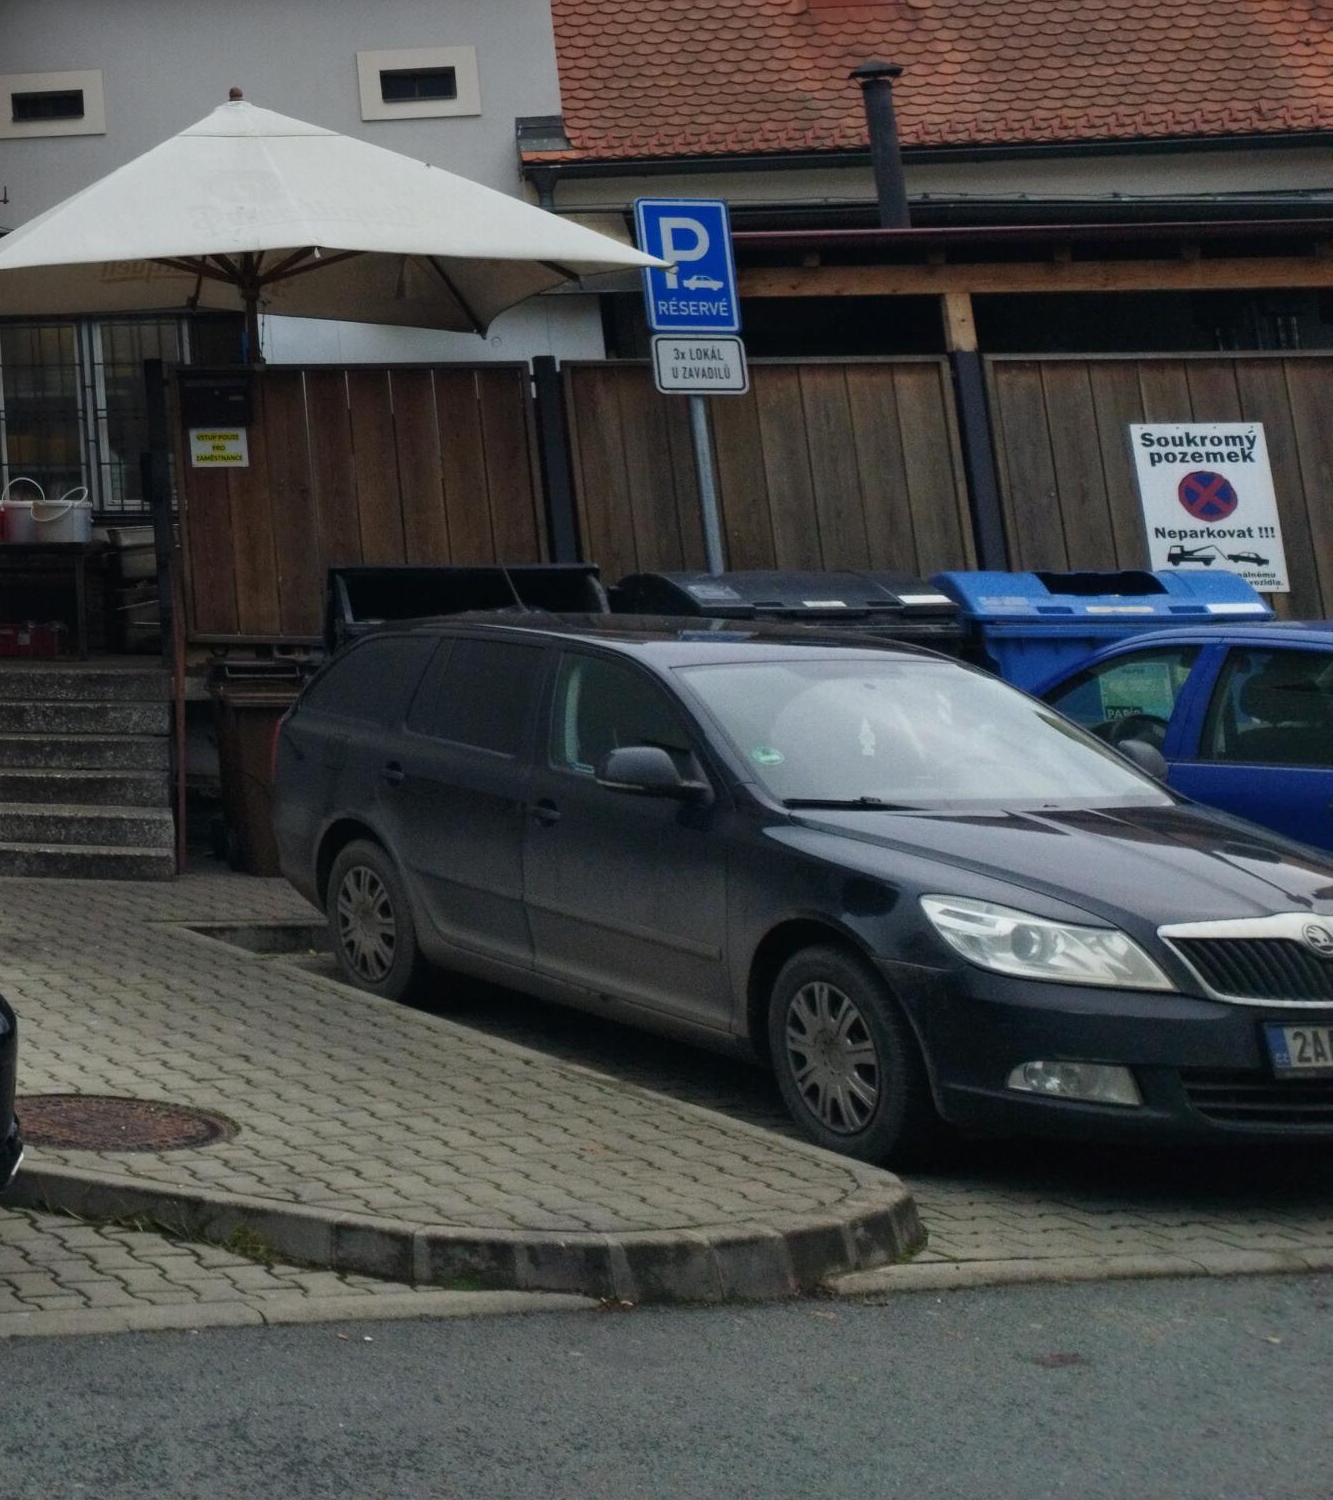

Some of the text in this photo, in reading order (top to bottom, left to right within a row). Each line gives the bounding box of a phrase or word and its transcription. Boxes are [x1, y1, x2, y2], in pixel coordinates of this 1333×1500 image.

[659, 217, 709, 290] P
[657, 297, 729, 317] RÉSERVÉ
[674, 345, 724, 361] 3x LOKÁL
[672, 365, 731, 380] U ZAVADILŮ
[1141, 430, 1257, 449] Soukromý
[1149, 449, 1255, 467] pozemek
[1154, 526, 1275, 541] Neparkovat !!!
[1237, 571, 1276, 579] nálnému
[1292, 1030, 1333, 1063] 2A
